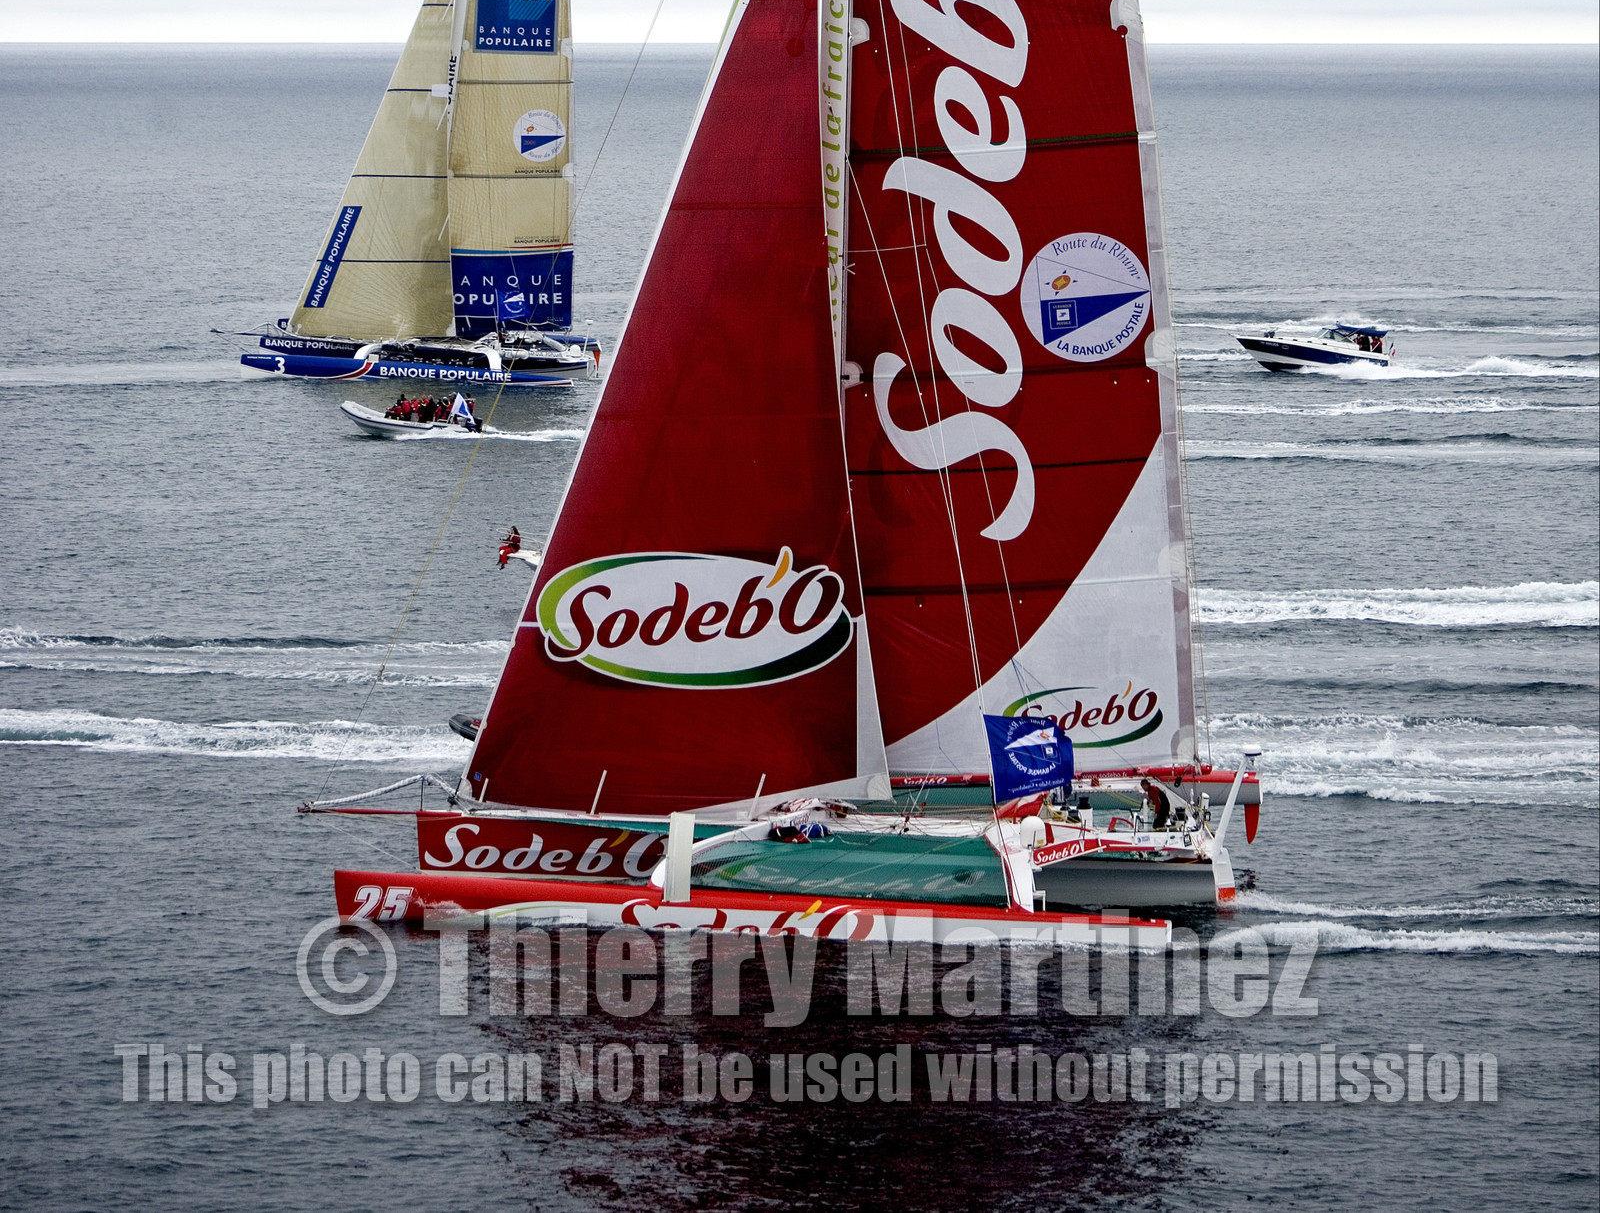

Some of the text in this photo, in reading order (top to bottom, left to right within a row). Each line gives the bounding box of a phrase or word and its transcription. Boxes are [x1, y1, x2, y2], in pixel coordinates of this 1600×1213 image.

[479, 26, 551, 36] BANQUE
[479, 37, 551, 47] POPULAIRE
[821, 114, 842, 152] la
[825, 162, 840, 209] de
[1051, 239, 1087, 256] Route
[1090, 235, 1107, 250] du
[310, 207, 355, 307] BANQUE POPULAIRE
[460, 274, 562, 288] ANQUE
[1057, 302, 1144, 355] LA BANQUE POSTALE
[265, 339, 355, 350] BANQUE POPULAIRE
[274, 357, 285, 374] 3
[440, 369, 512, 382] POPULAIRE
[548, 551, 842, 658] Sodeb'O
[1034, 843, 1080, 864] Sodeb'O
[349, 885, 414, 921] 25
